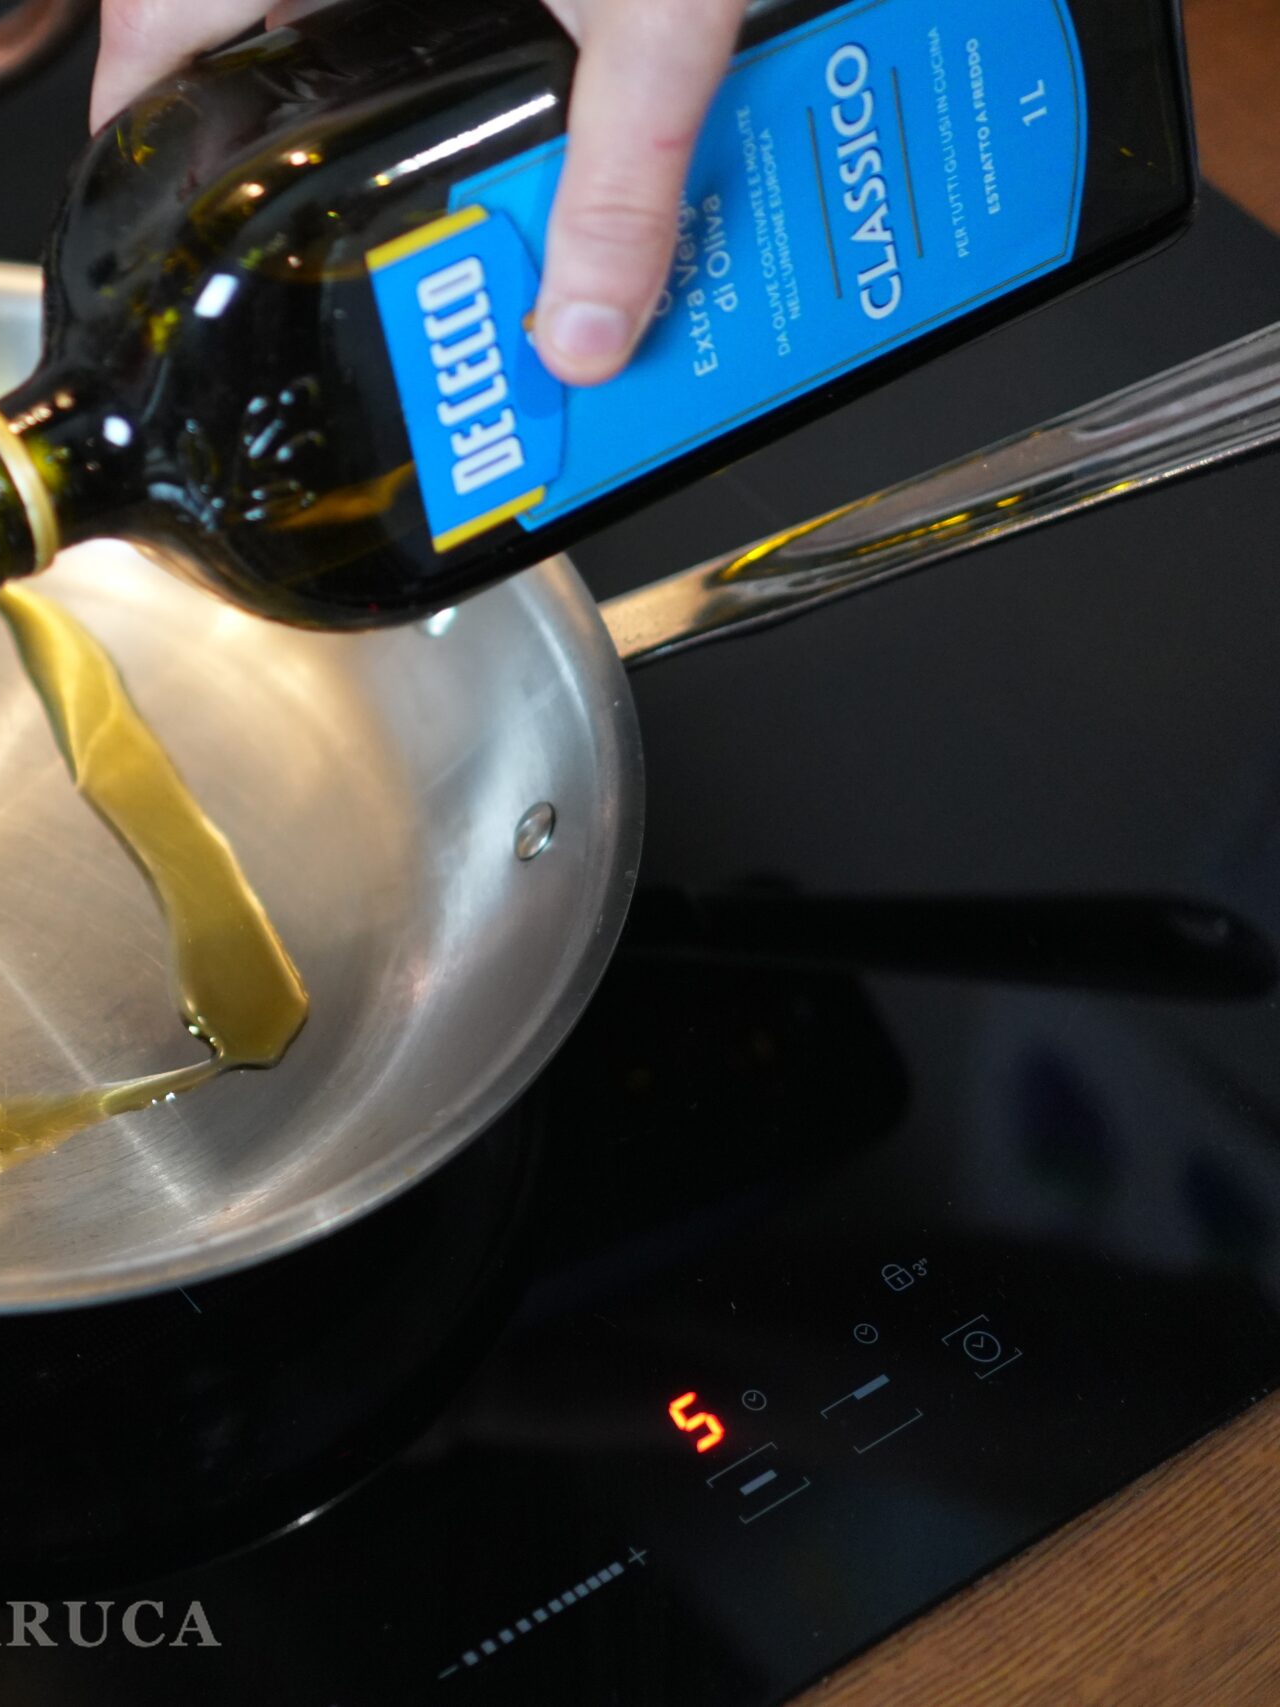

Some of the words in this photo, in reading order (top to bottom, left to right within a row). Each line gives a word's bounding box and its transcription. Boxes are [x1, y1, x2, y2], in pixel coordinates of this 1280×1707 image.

[927, 26, 947, 94] CUCINA
[965, 38, 986, 110] FREDDO
[936, 94, 949, 114] IN
[938, 114, 953, 144] USI
[975, 110, 988, 122] A
[759, 127, 782, 208] EUROPEA
[825, 43, 902, 320] CLASSICO
[942, 144, 957, 173] GLI
[977, 126, 1001, 215] ESTRATTO
[946, 174, 965, 226] TUTTI
[702, 194, 732, 279] Oliva
[749, 186, 777, 279] COLTIVATE
[954, 226, 970, 258] PER
[771, 209, 801, 320] NELL'UNIONE
[713, 282, 739, 313] di
[765, 280, 786, 330] OLIVE
[686, 288, 719, 378] Extra
[776, 331, 791, 356] DA
[669, 1391, 725, 1453] 5
